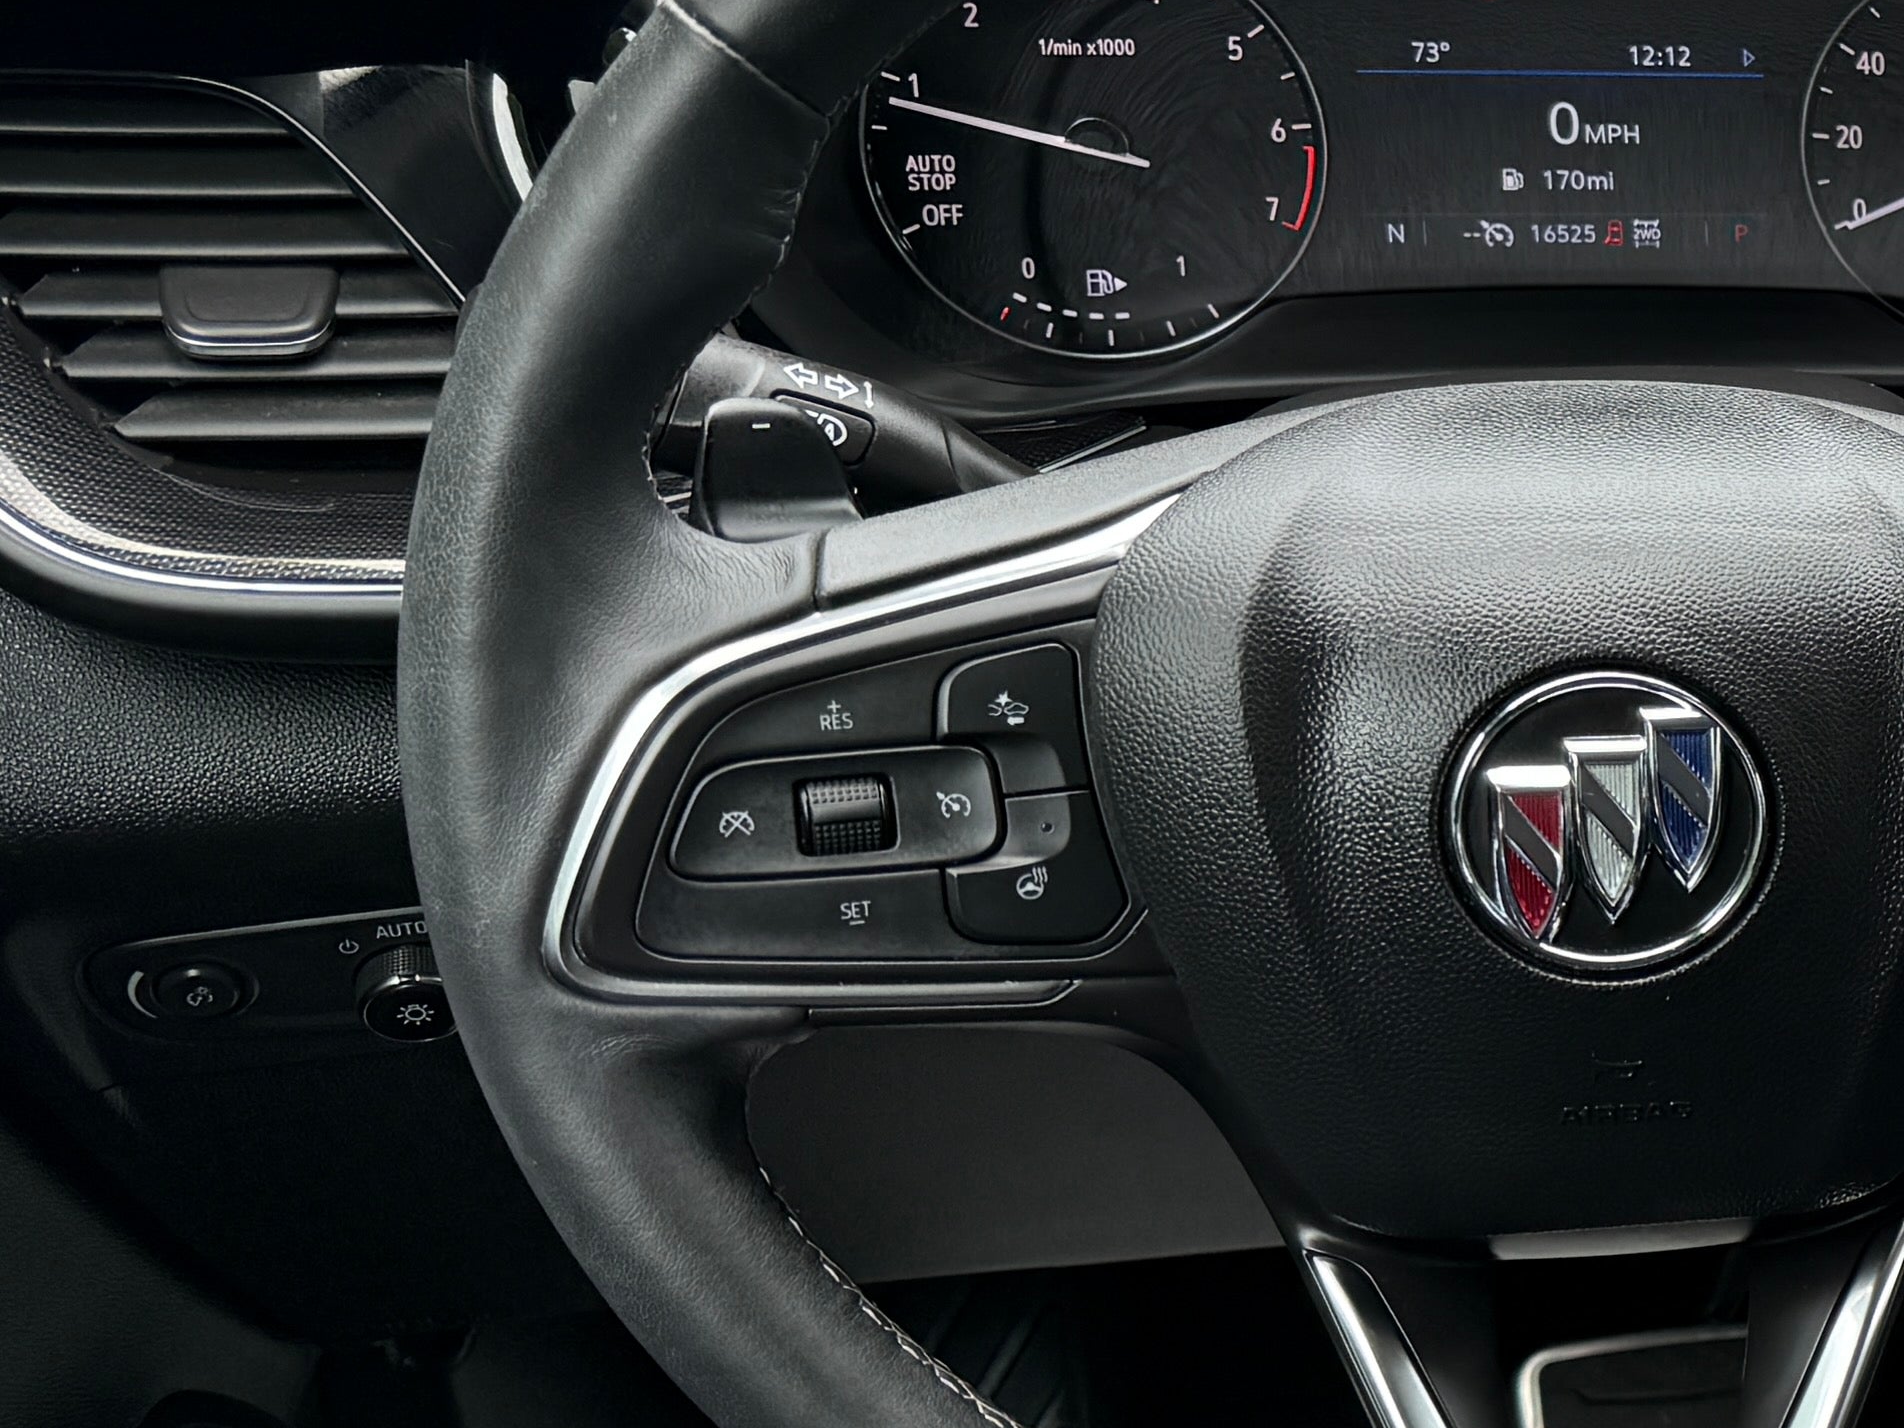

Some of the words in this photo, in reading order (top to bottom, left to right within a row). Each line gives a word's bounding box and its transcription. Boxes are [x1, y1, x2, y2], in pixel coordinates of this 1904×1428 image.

[963, 2, 979, 28] 2
[1038, 38, 1083, 58] 1/min
[1086, 37, 1136, 57] x1000
[1227, 37, 1243, 61] 5
[1628, 46, 1692, 68] 12:12
[1855, 51, 1886, 76] 40
[908, 73, 920, 98] 1
[1270, 119, 1287, 144] 6
[1549, 101, 1581, 146] 0
[1585, 124, 1641, 145] MPH
[1835, 125, 1864, 150] 20
[905, 154, 957, 173] AUTO
[908, 173, 957, 192] STOP
[921, 204, 964, 227] OFF
[1265, 196, 1279, 221] 7
[1852, 199, 1867, 222] 0
[1387, 224, 1405, 243] N
[1531, 224, 1597, 244] 16525
[1735, 224, 1749, 242] P
[1020, 257, 1036, 279] 0
[1176, 255, 1187, 278] 1
[819, 712, 854, 731] RES
[840, 900, 872, 921] SET
